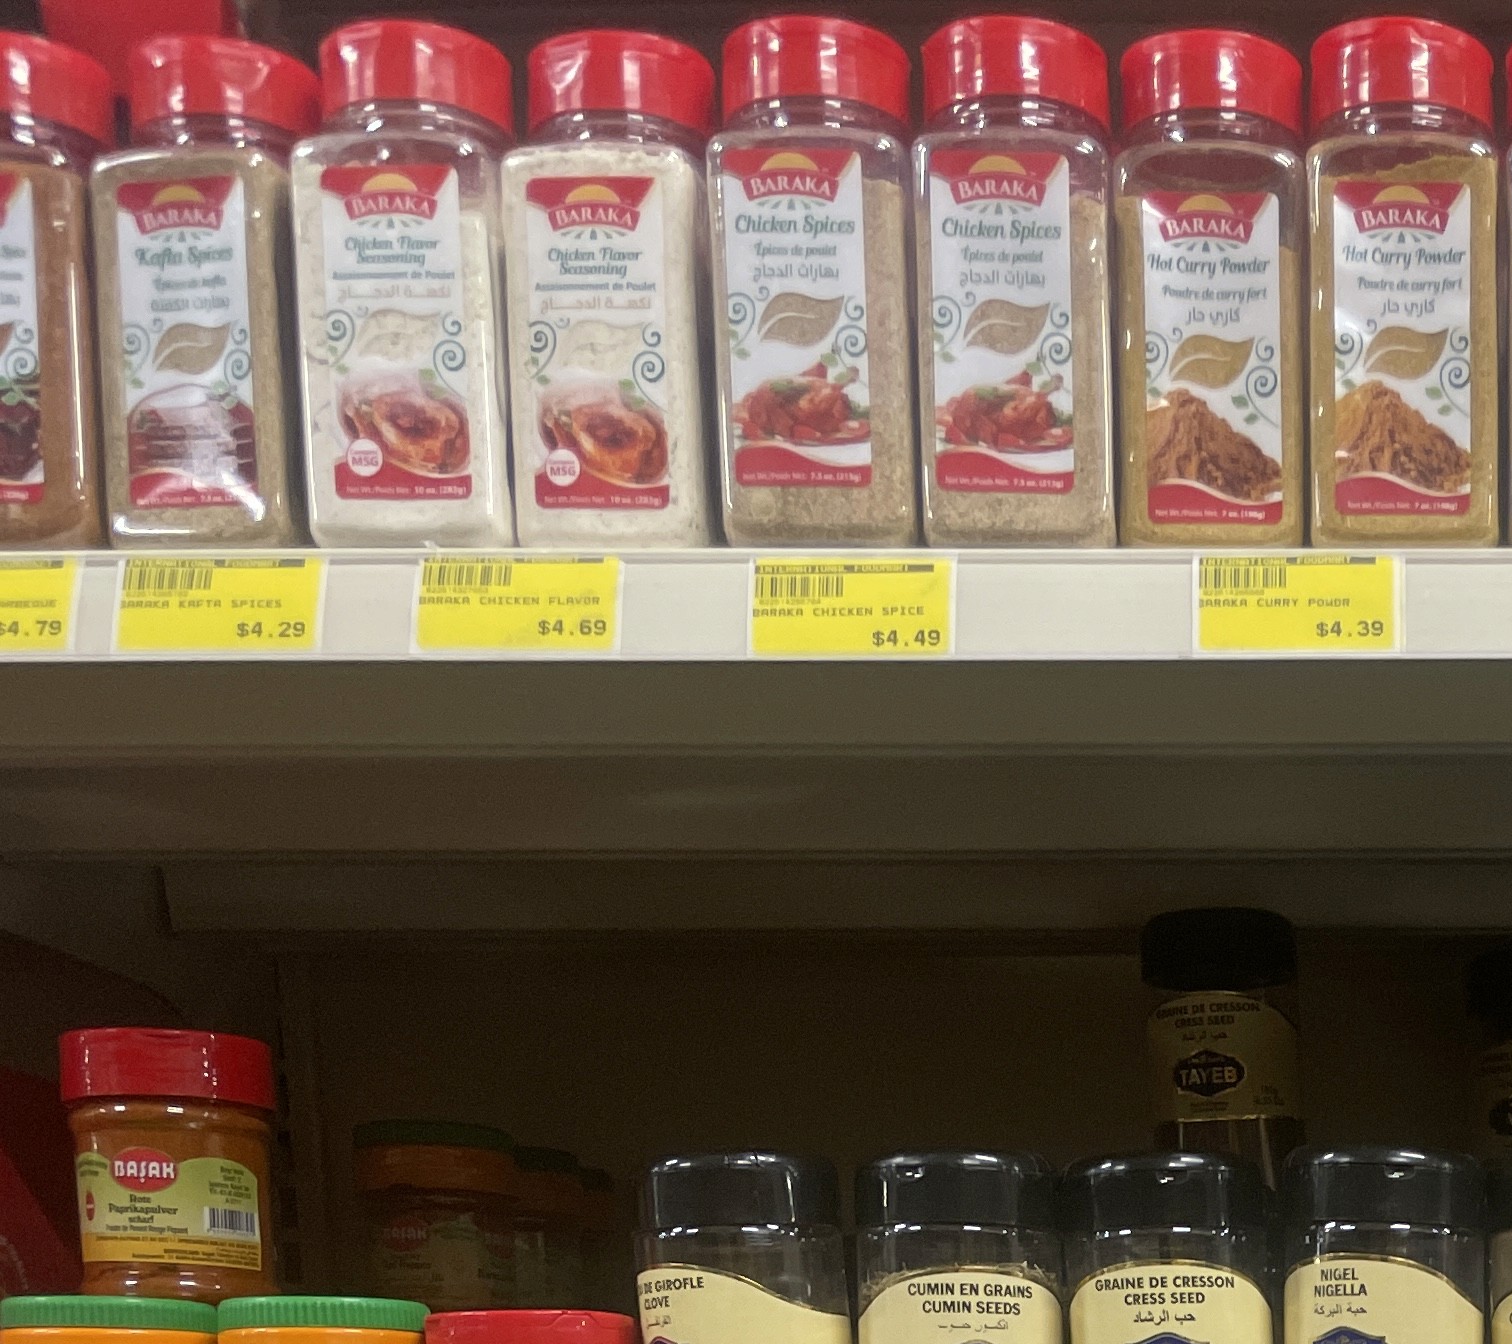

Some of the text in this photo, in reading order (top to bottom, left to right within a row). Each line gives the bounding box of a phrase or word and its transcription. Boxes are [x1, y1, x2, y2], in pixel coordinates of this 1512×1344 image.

[750, 176, 832, 198] BARAKA
[555, 207, 633, 226] BARAKA
[1360, 207, 1441, 231] BARAKA
[735, 216, 854, 236] Chicken Spices
[1165, 217, 1246, 240] BARAKA
[1342, 245, 1465, 270] Hot Curry Powder
[480, 596, 541, 606] CHICKEN
[547, 596, 600, 606] FLAVOR
[1256, 598, 1350, 608] CURRY POWDR
[236, 621, 306, 639] $4.29
[537, 618, 607, 637] $4.69
[1316, 620, 1384, 638] $4.39
[872, 628, 941, 648] $4.49
[1094, 1275, 1235, 1292] GRAINE DE CRESSON
[1320, 1267, 1360, 1282] NIGEL
[907, 1282, 1033, 1299] CUMIN EN GRAINS
[1124, 1291, 1206, 1306] CRESS SEED
[1313, 1283, 1368, 1298] NIGELLA
[922, 1300, 1021, 1316] CUMIN SEEDS
